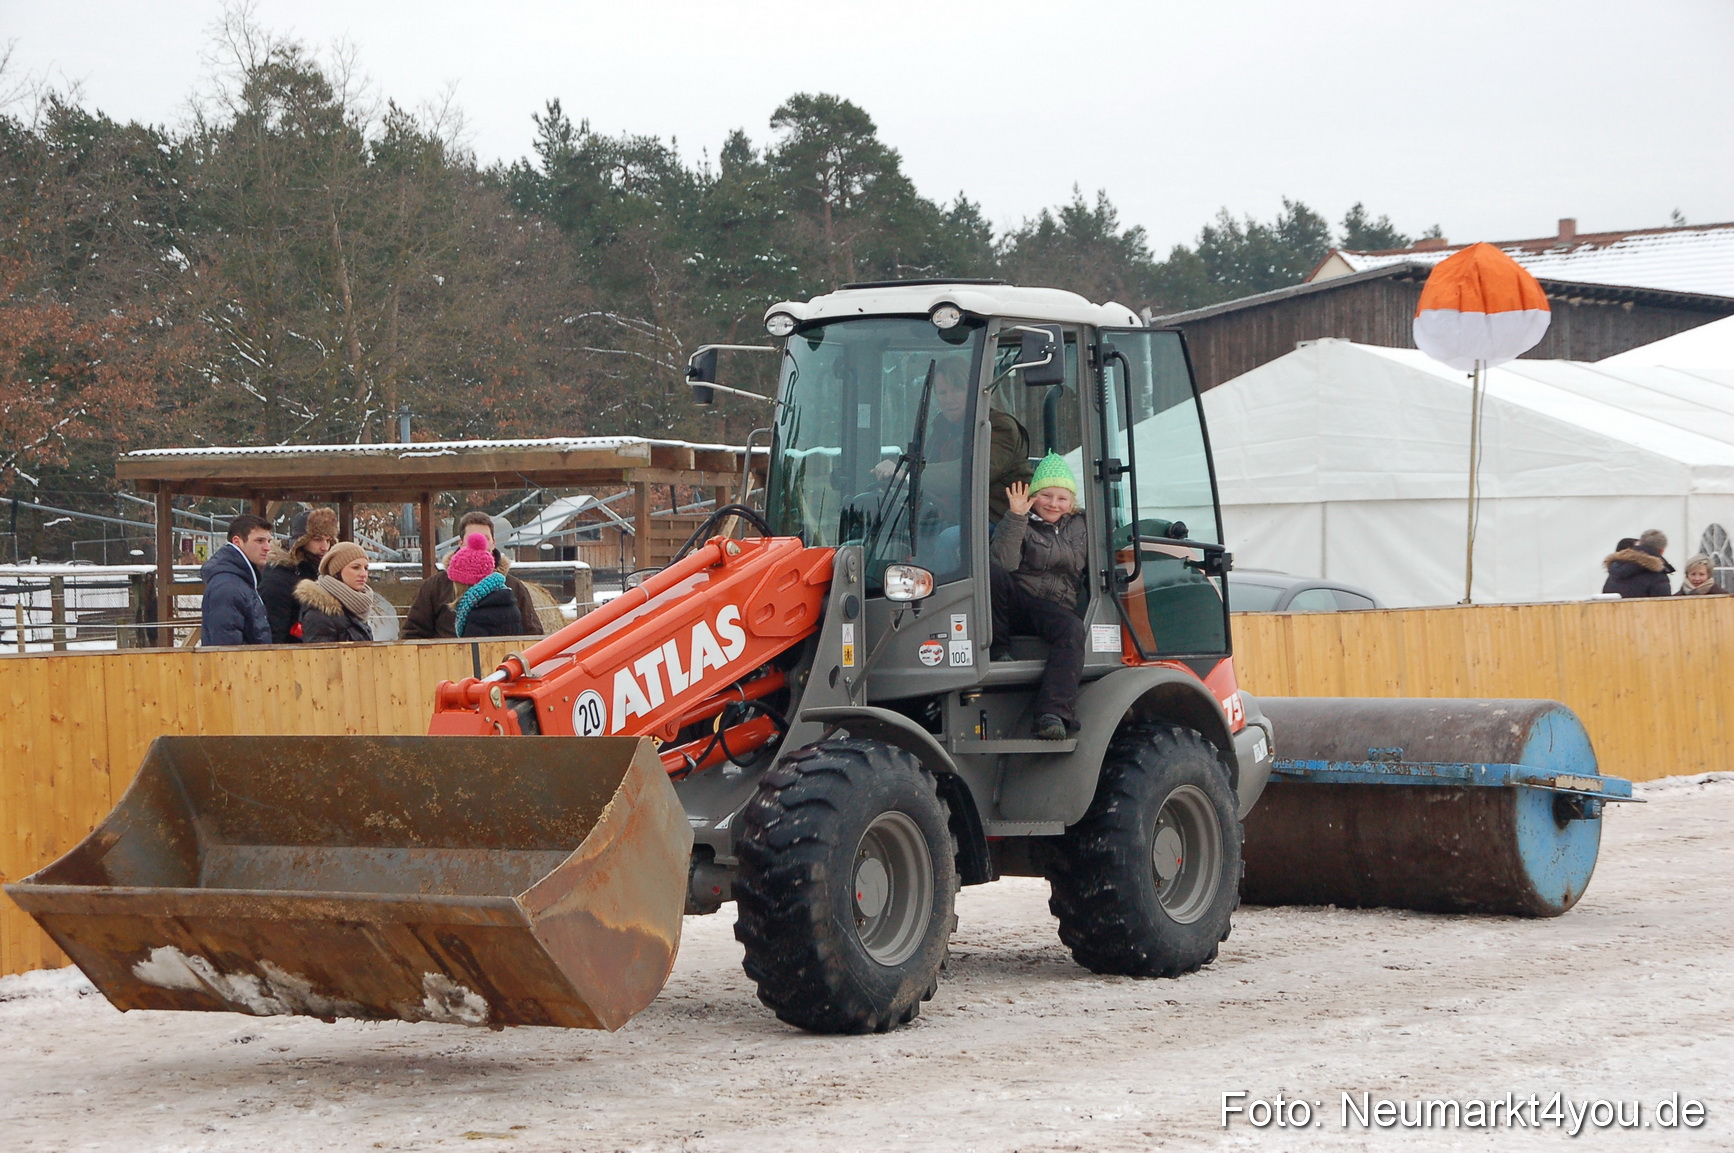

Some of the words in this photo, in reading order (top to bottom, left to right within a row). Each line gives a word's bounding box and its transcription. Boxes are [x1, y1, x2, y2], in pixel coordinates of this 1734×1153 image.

[611, 604, 746, 735] ATLAS
[952, 652, 966, 663] 100
[579, 698, 600, 735] 20
